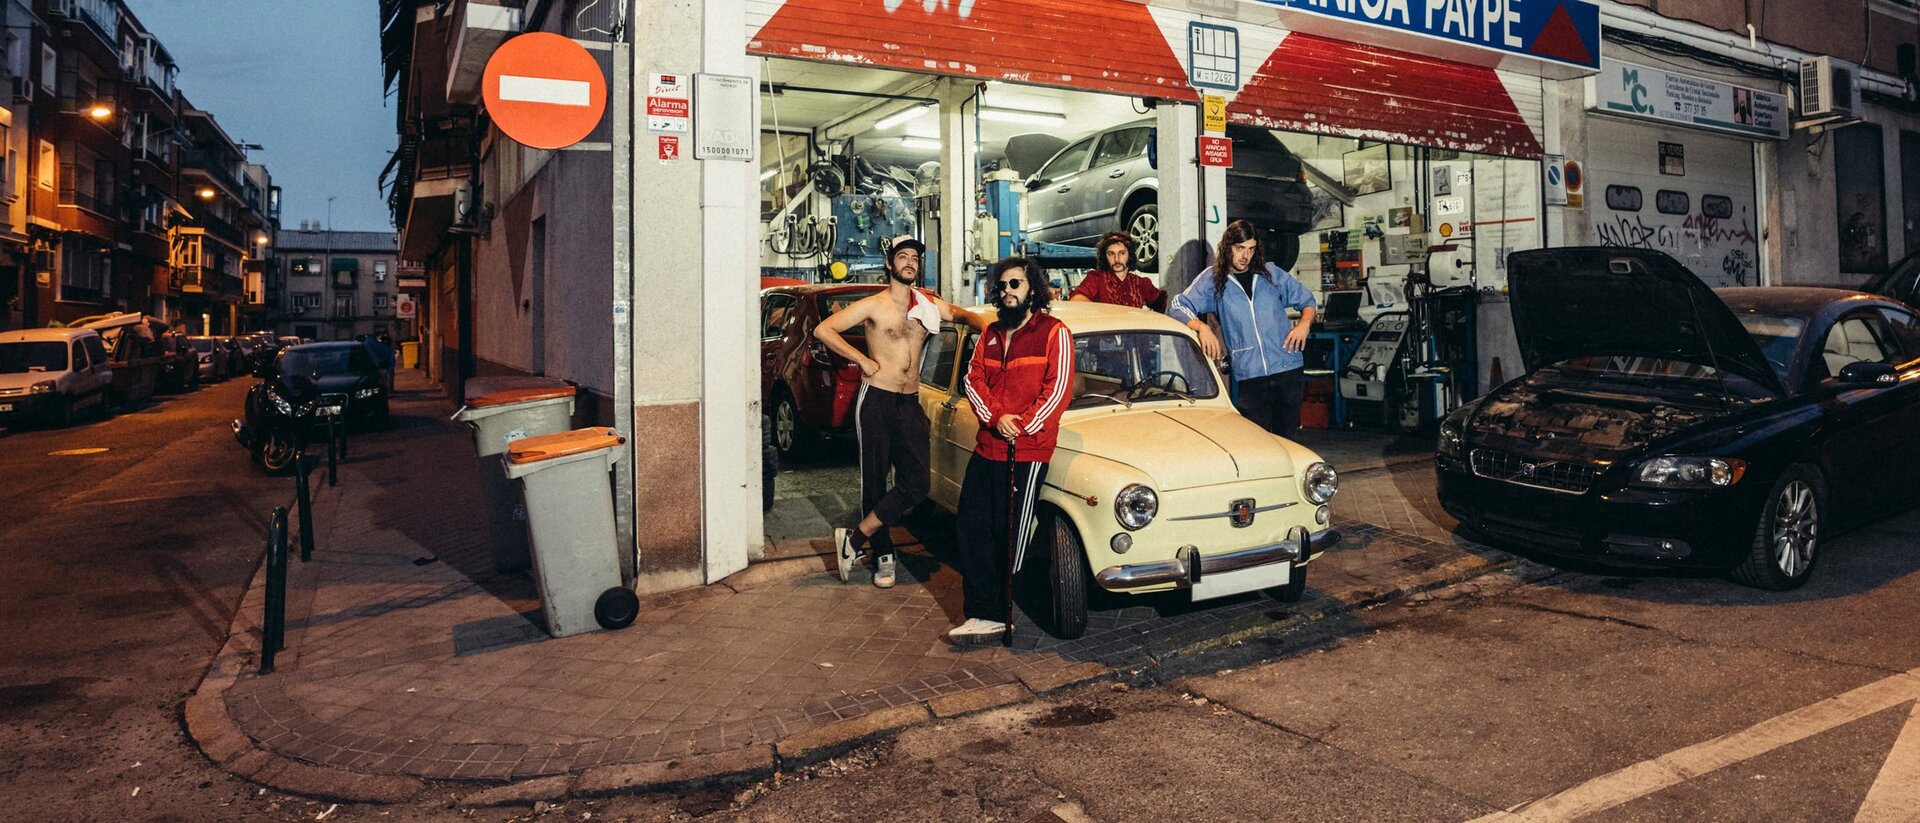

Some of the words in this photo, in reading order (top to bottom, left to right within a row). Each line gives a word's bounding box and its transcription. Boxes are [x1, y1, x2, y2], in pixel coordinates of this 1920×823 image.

[1424, 0, 1523, 48] PAYPE
[649, 98, 687, 109] Alarma
[702, 146, 749, 156] 1500001071
[1205, 144, 1227, 152] APARCAR
[1204, 150, 1228, 158] AVISAMOS
